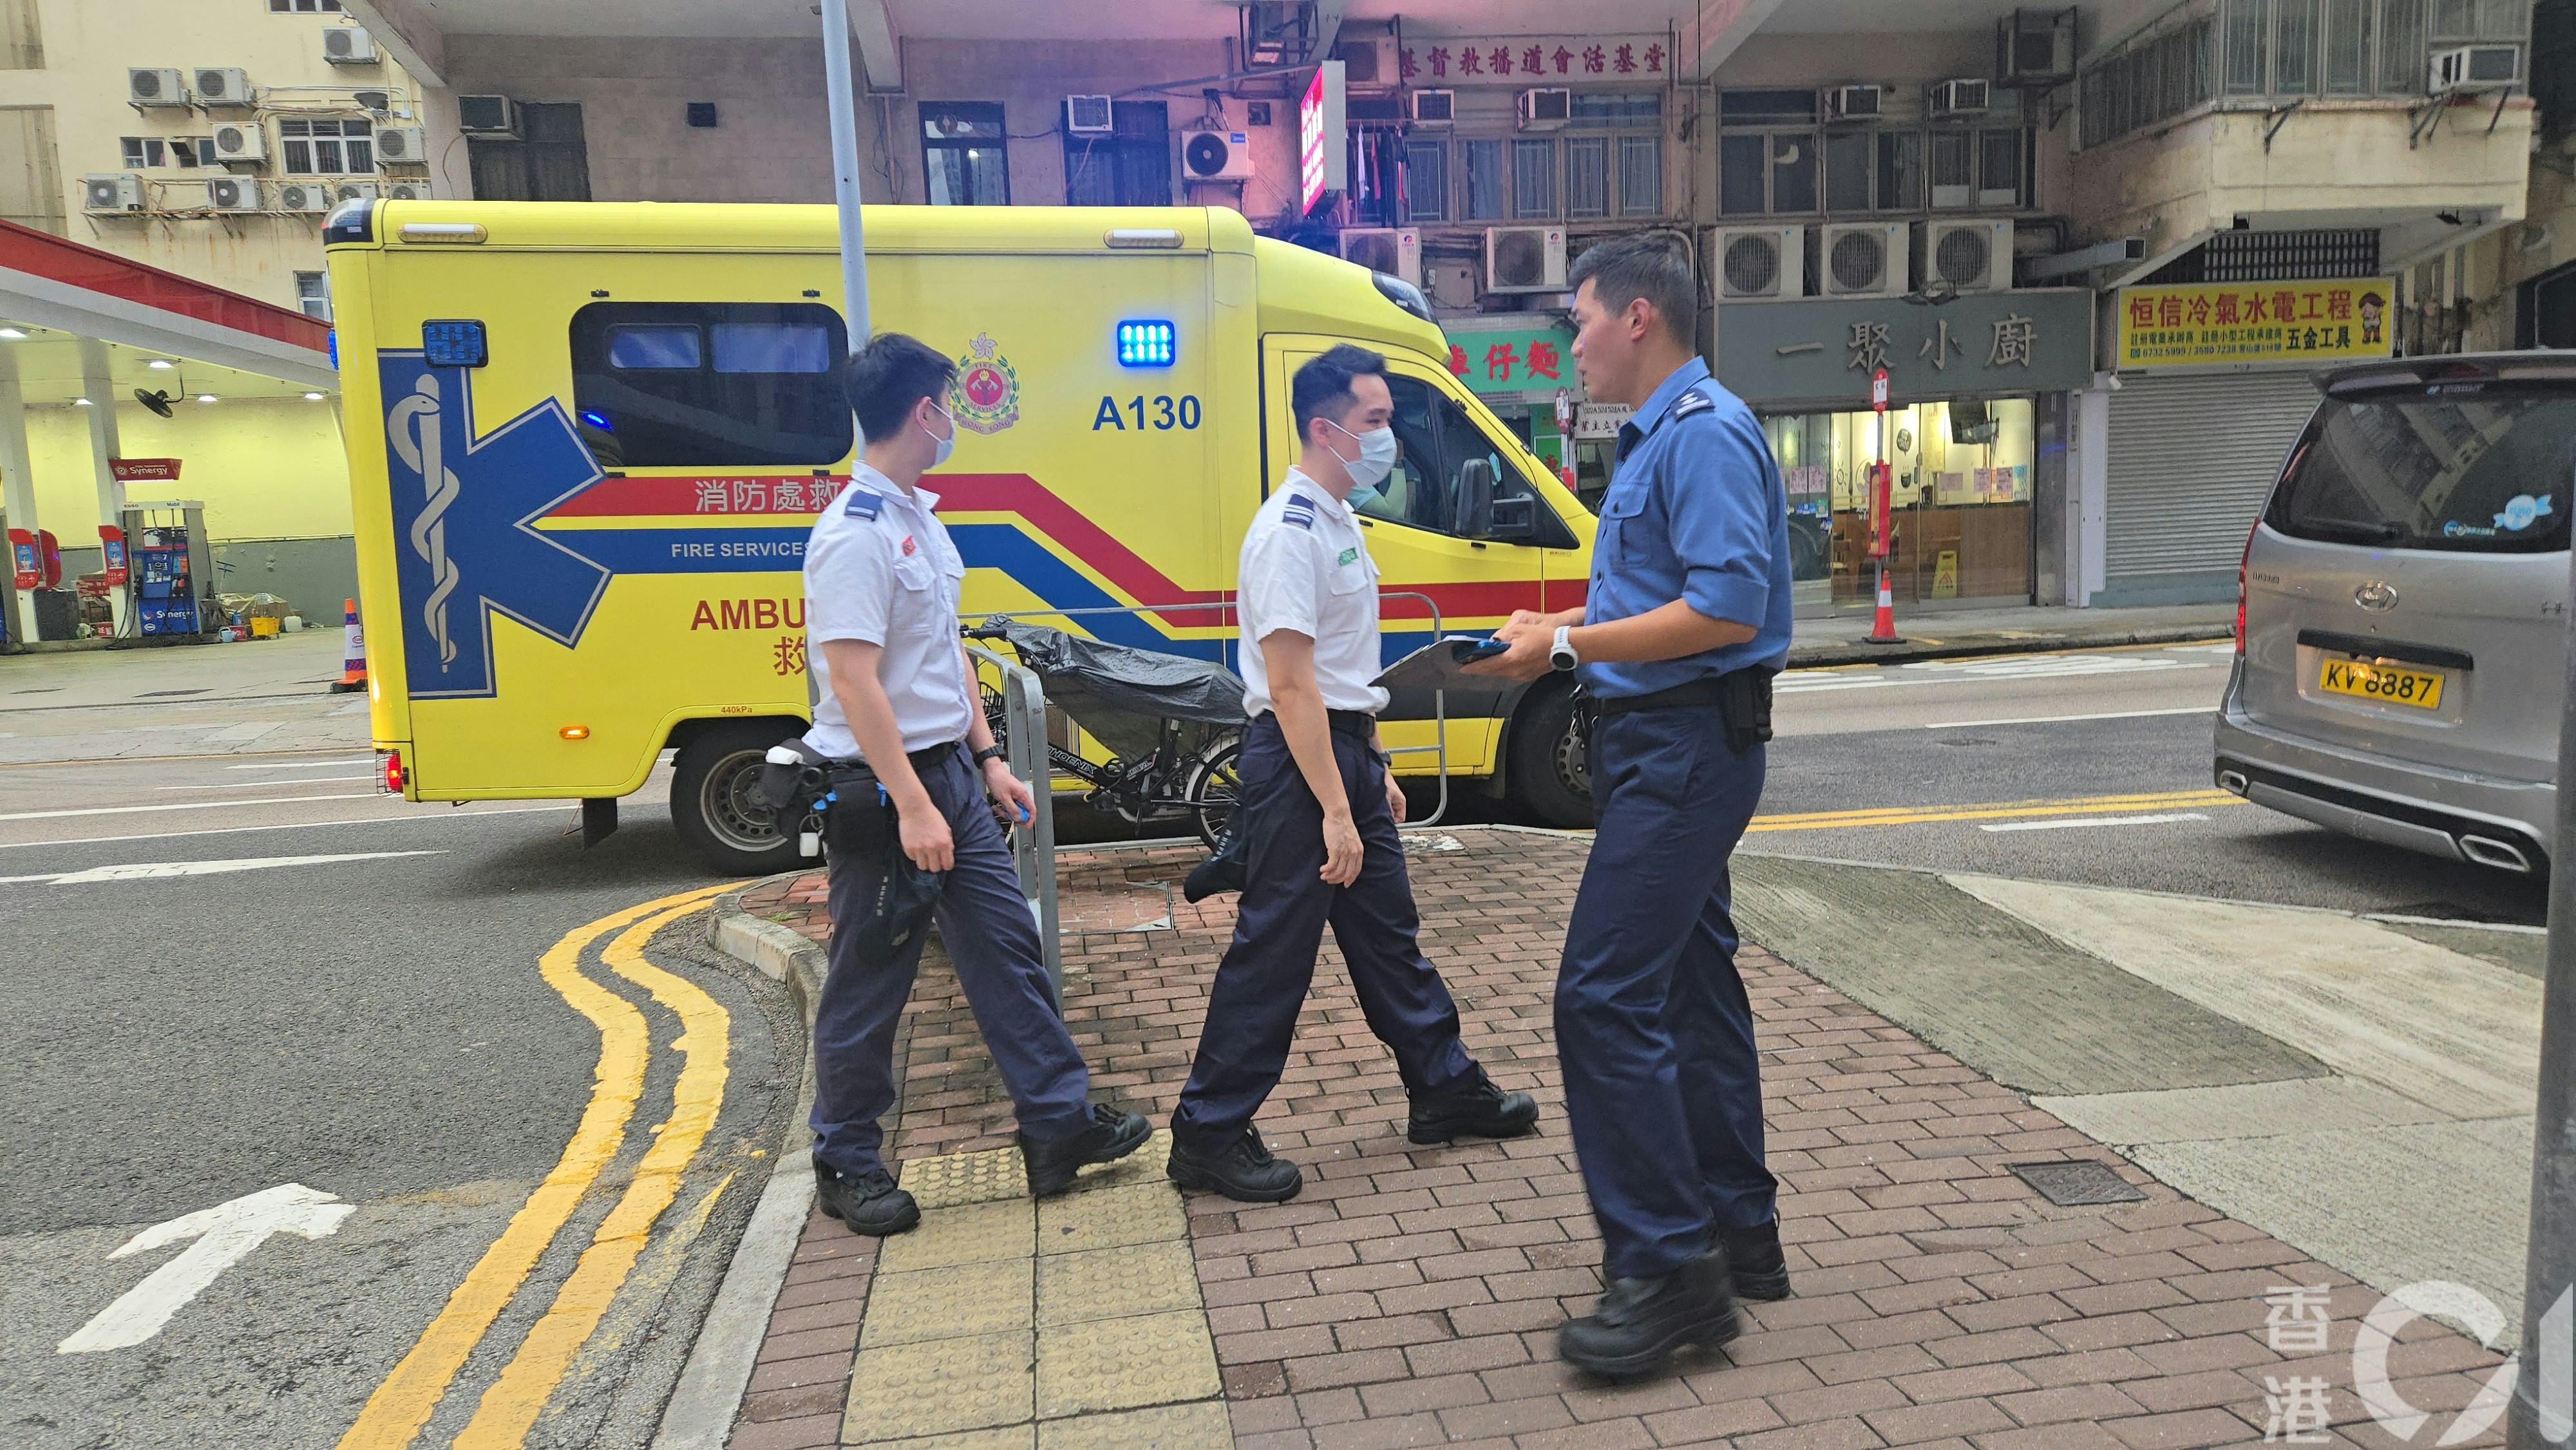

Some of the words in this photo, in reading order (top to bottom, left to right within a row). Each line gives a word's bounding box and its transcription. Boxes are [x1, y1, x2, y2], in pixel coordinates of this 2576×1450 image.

[1401, 43, 1665, 78] 基督教播道會活基堂
[2129, 289, 2352, 329] 恒信冷氣水電工程
[1776, 313, 2038, 373] 一聚小廚
[2286, 325, 2351, 350] 五金工具
[969, 401, 1001, 413] SERVICES
[1092, 395, 1201, 431] A130
[961, 419, 985, 433] HONG
[988, 420, 1010, 432] KONG
[129, 466, 168, 476] Synergy
[694, 478, 851, 512] 消防處救
[671, 543, 715, 558] FIRE
[2327, 664, 2356, 690] KV
[2364, 670, 2434, 702] 8887
